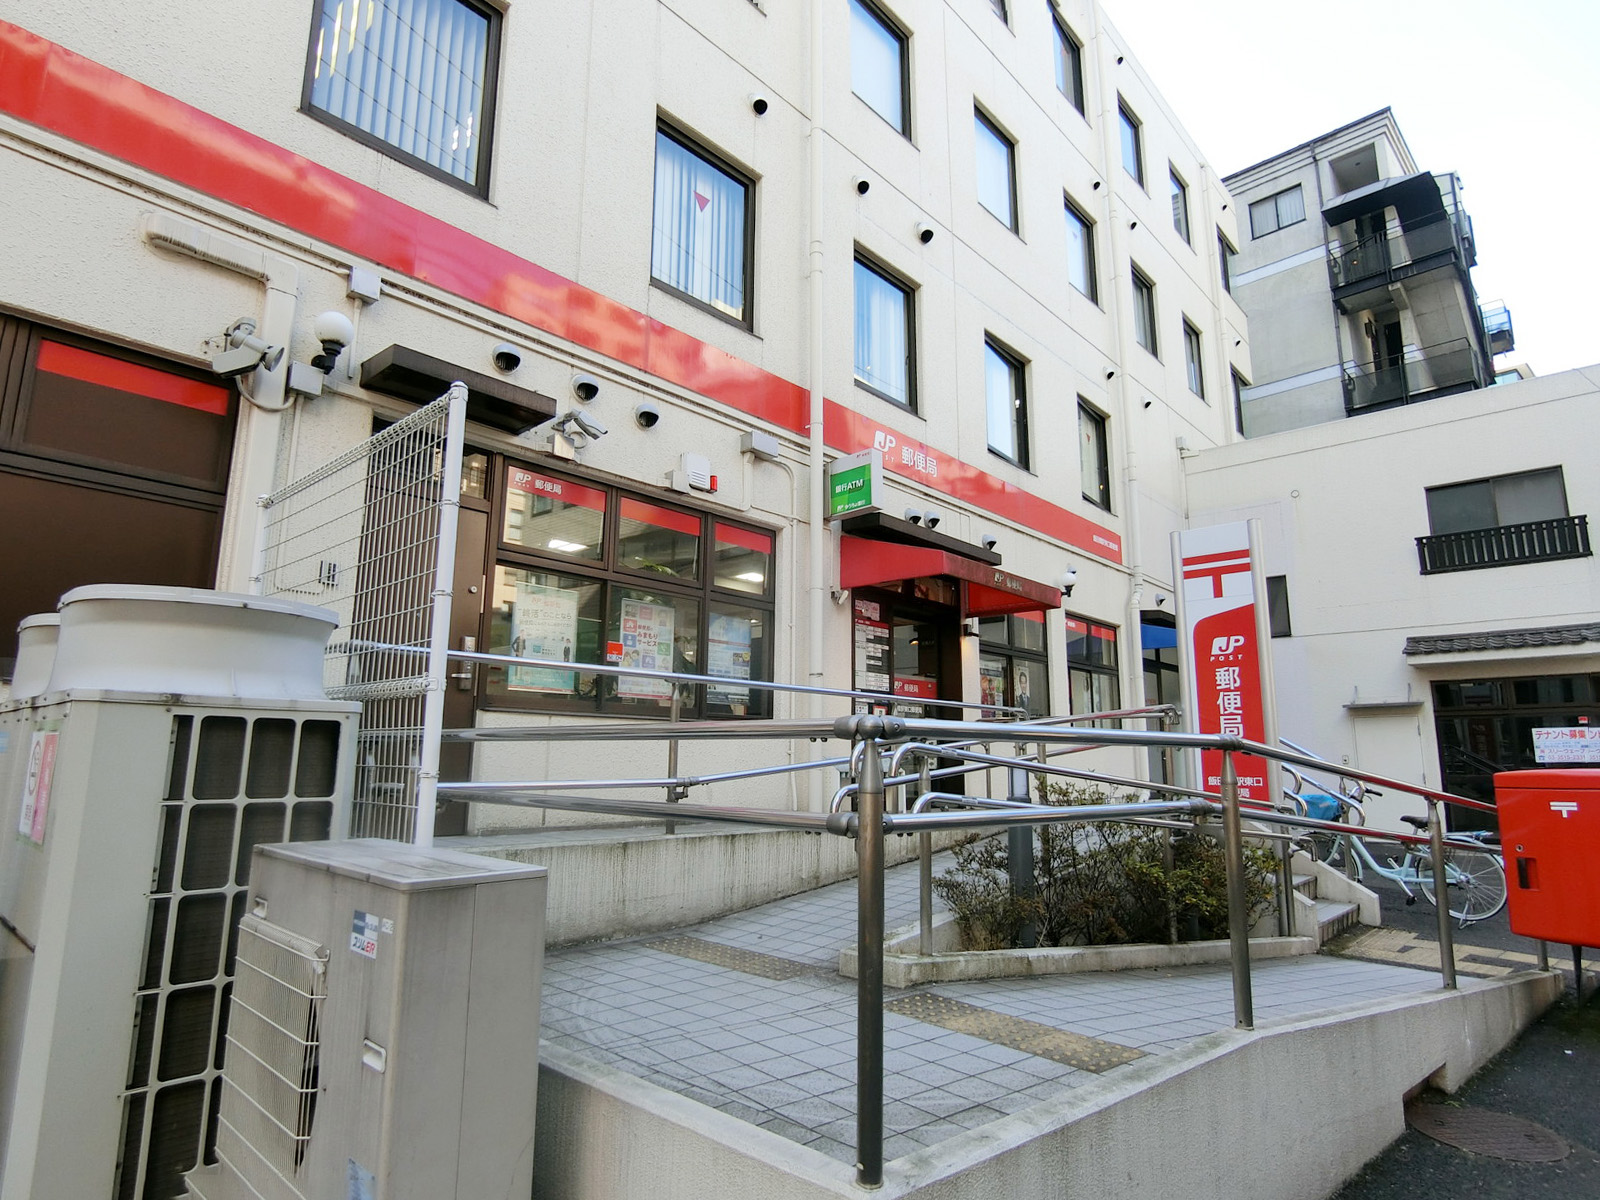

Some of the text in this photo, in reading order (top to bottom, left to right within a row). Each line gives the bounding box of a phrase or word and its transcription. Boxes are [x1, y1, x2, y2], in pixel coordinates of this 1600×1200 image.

[873, 430, 938, 477] JP 郵便局
[514, 472, 531, 483] JP
[534, 479, 562, 495] 郵便局
[835, 478, 864, 493] 銀行ATM
[637, 631, 658, 640] みまもり
[637, 639, 657, 647] サービス
[1211, 635, 1245, 655] JP
[1215, 666, 1244, 738] 郵便局
[1535, 729, 1586, 740] テナント募集
[1208, 775, 1263, 786] 飯田駅東口
